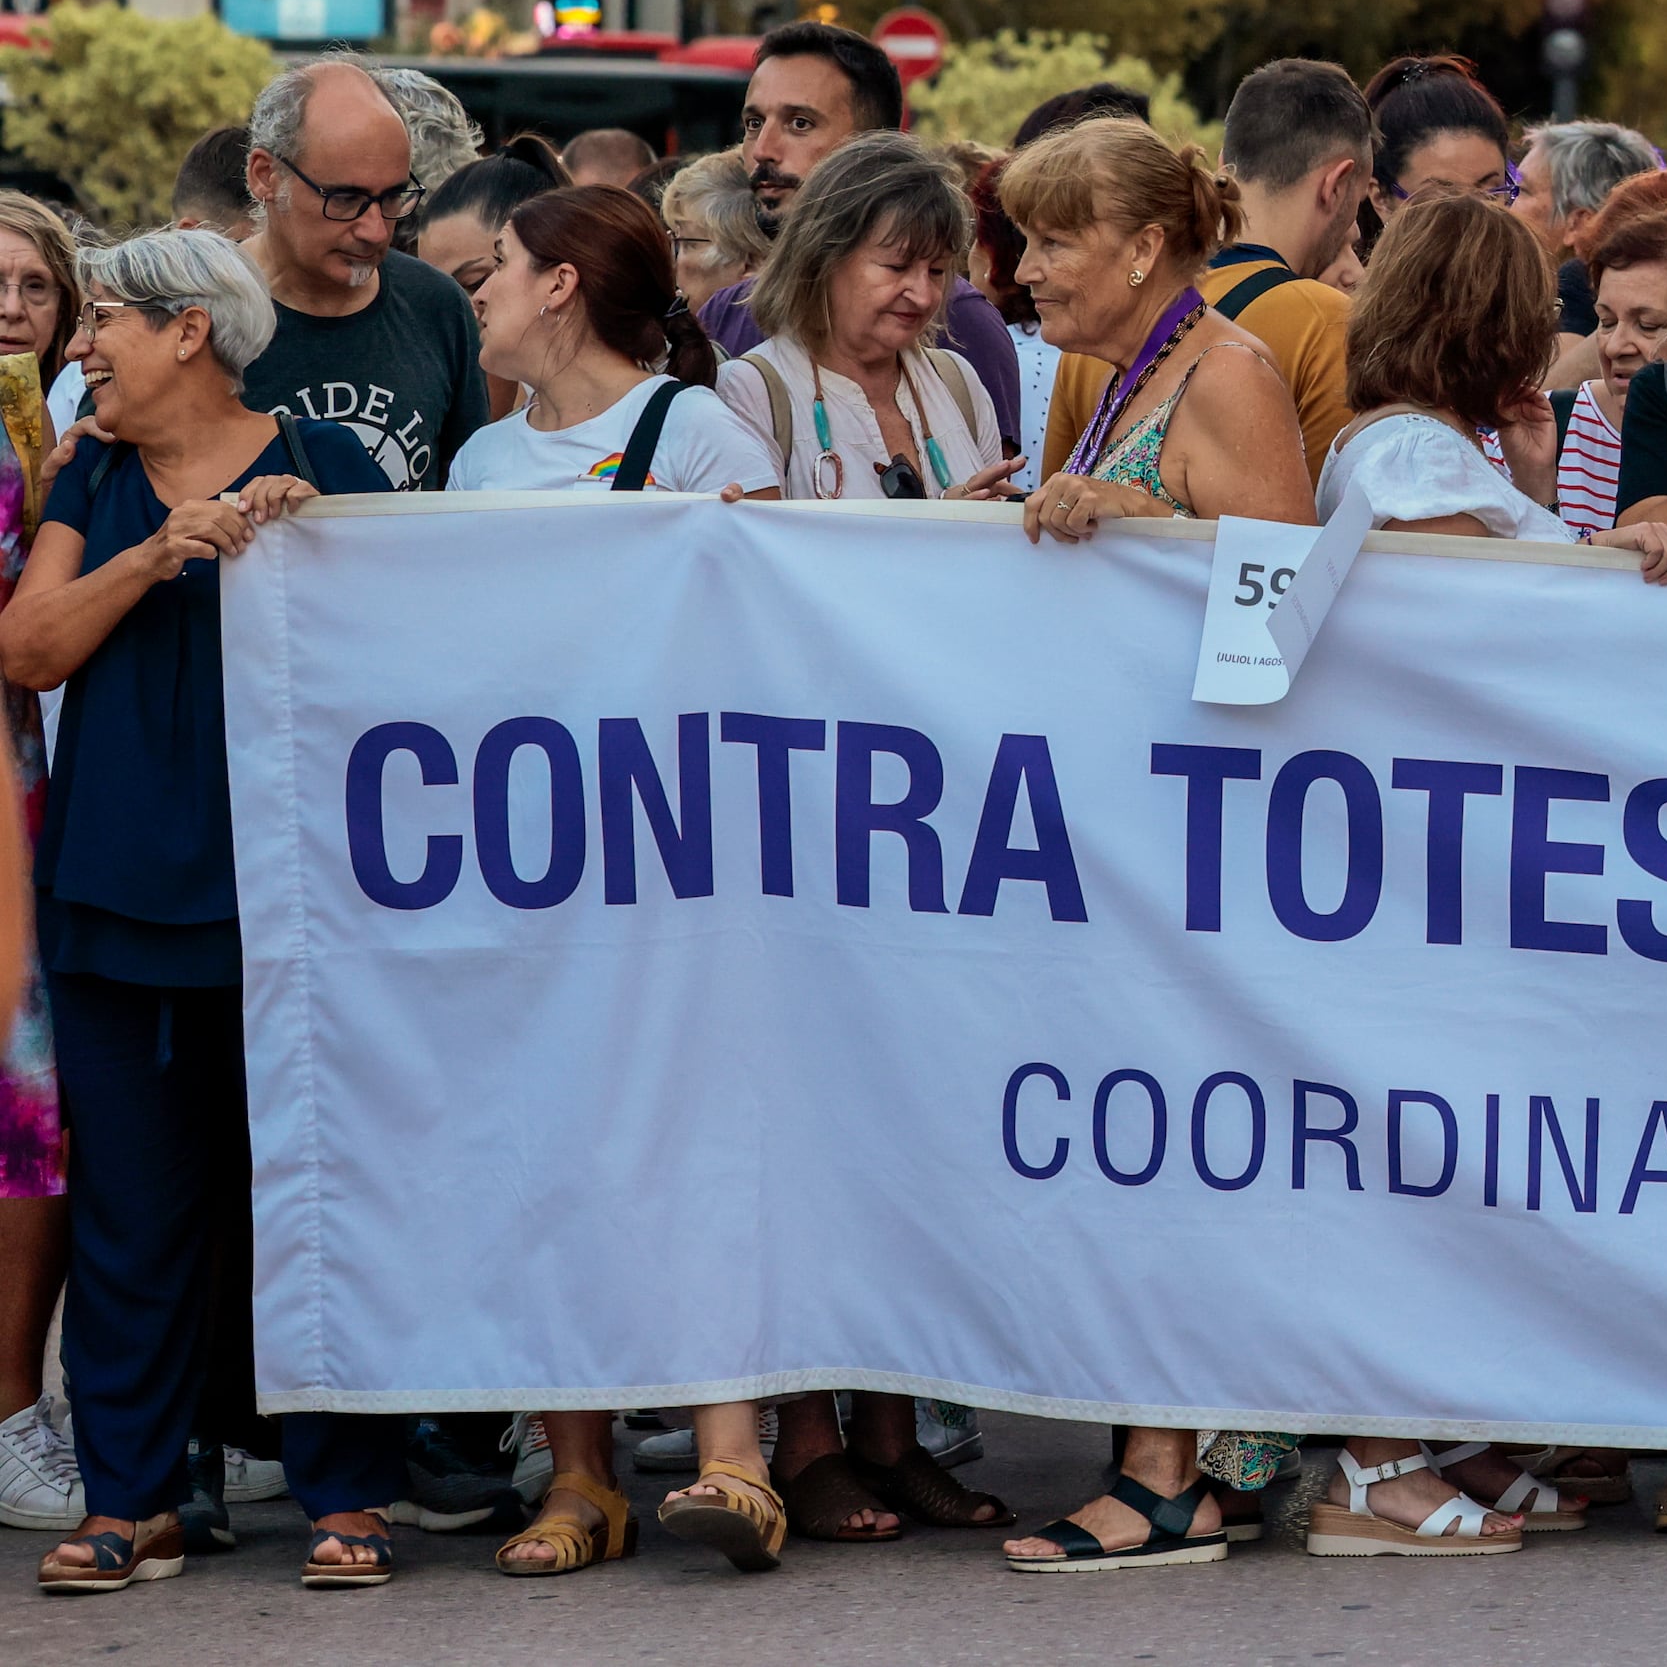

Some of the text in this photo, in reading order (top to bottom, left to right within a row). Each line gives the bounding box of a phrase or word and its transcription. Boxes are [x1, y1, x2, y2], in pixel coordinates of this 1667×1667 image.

[267, 381, 432, 491] IDE LO
[1216, 651, 1251, 665] (JULIOL
[1253, 657, 1257, 665] I
[344, 710, 1090, 924] CONTRA
